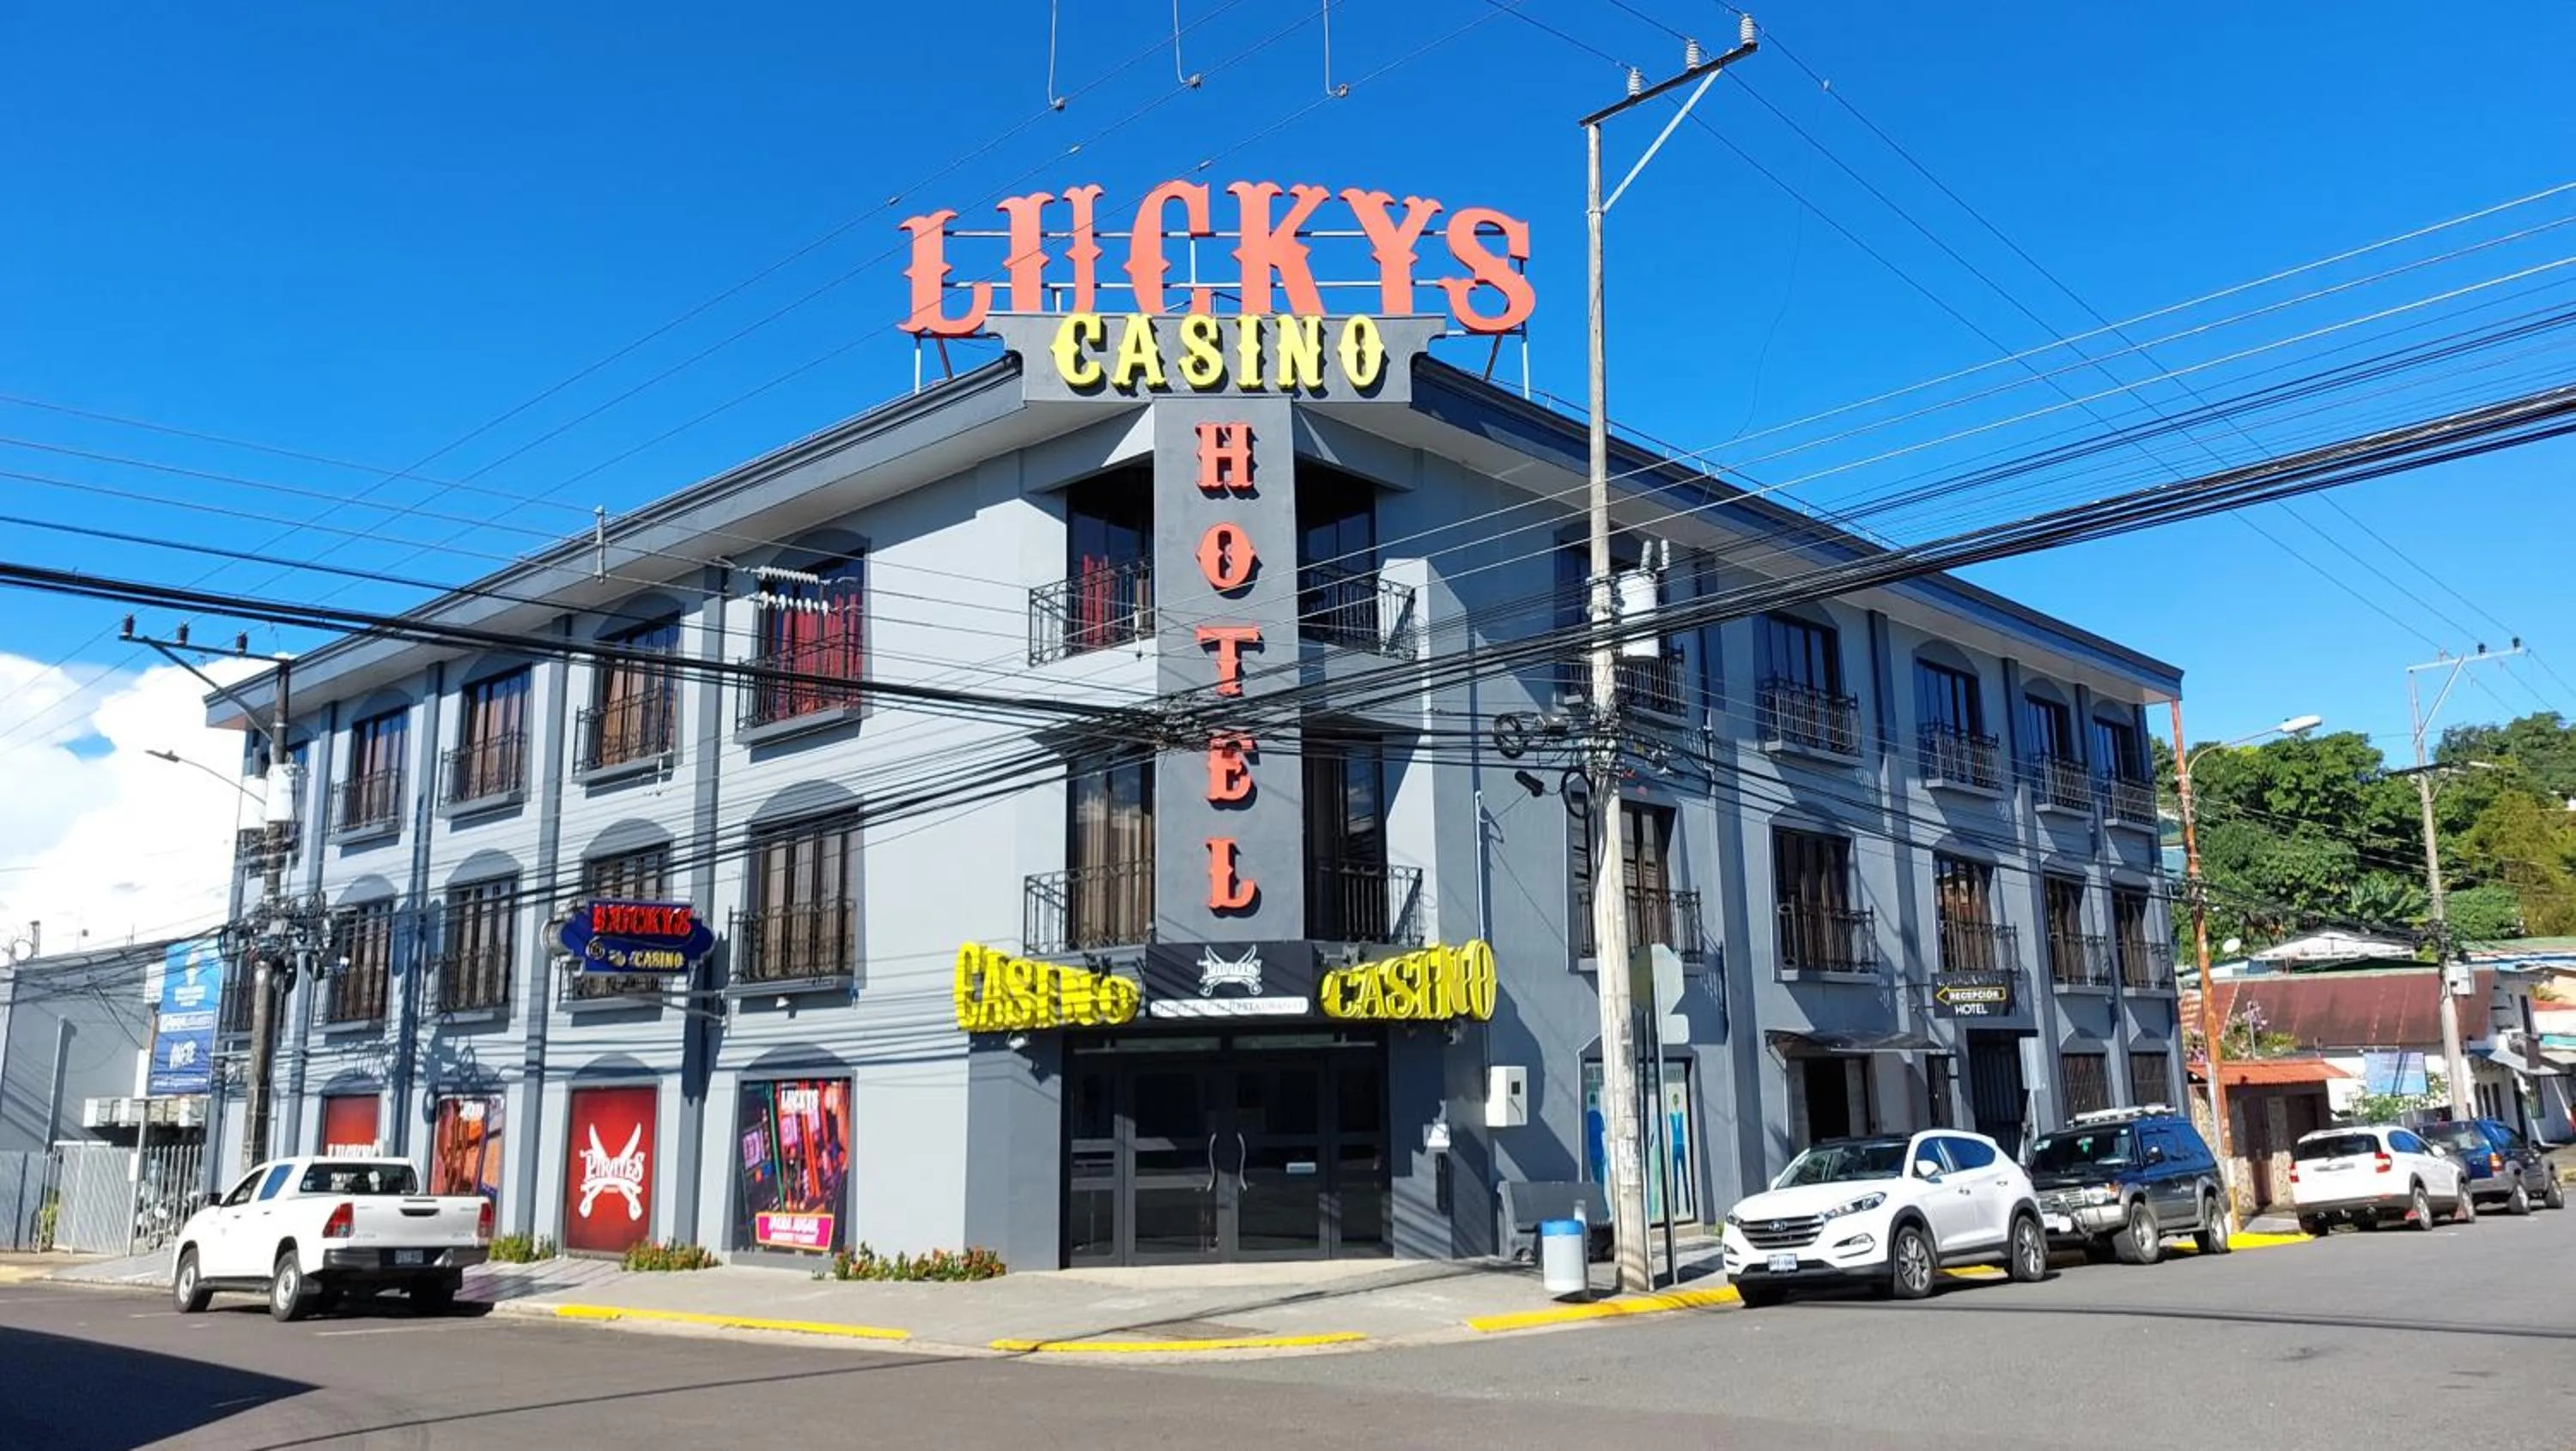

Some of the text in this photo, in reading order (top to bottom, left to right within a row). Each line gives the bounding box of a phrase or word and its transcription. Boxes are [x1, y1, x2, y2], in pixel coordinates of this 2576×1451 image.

[898, 179, 1536, 334] LUCKYS
[1051, 313, 1384, 388] CASINO
[1194, 422, 1261, 909] HOTEL
[633, 950, 685, 969] CASINO
[953, 941, 1140, 1029] CASINO
[1321, 938, 1497, 1022] CASINO
[1954, 1003, 1989, 1015] HOTEL
[580, 1149, 646, 1183] PIRATES
